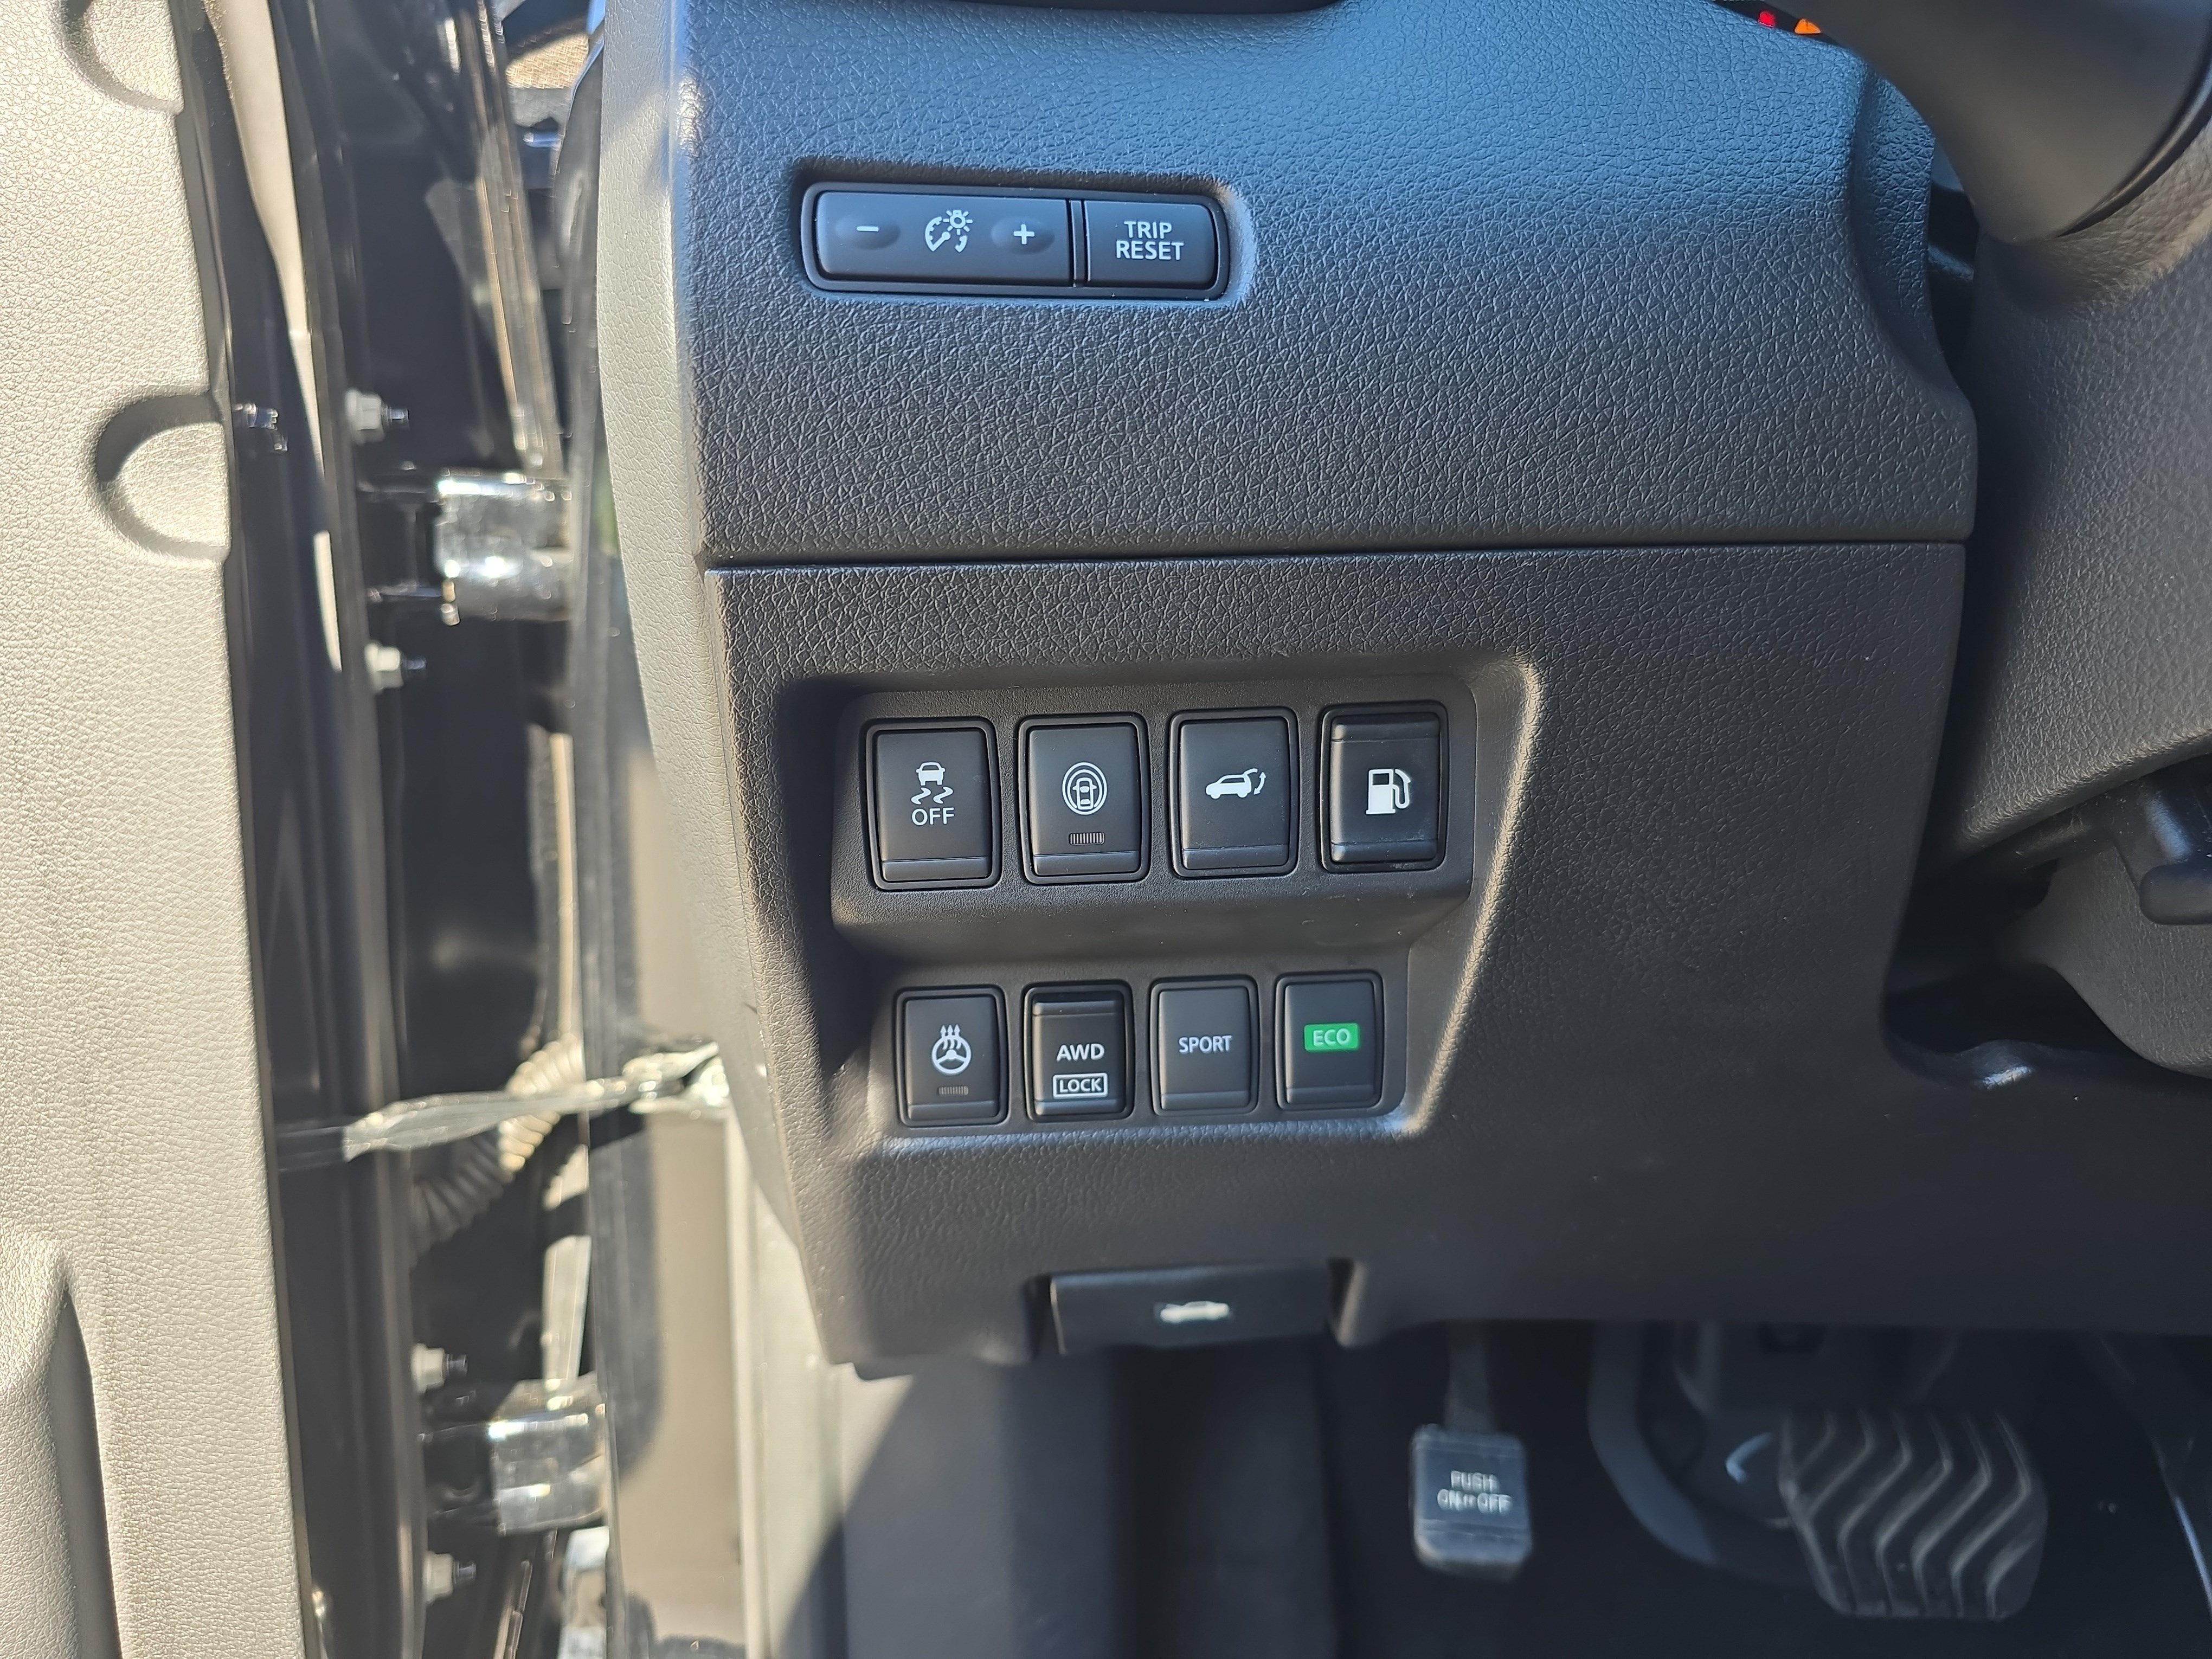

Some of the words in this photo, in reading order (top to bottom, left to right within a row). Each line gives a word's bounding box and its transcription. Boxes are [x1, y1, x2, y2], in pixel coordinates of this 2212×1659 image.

[1123, 220, 1172, 239] TRIP
[1115, 240, 1184, 261] RESET
[911, 807, 955, 826] OFF
[1178, 1035, 1233, 1054] SPORT
[1313, 1028, 1352, 1047] ECO
[1056, 1044, 1105, 1062] AWD
[1059, 1077, 1102, 1093] LOCK
[1450, 1470, 1500, 1493] PUSH
